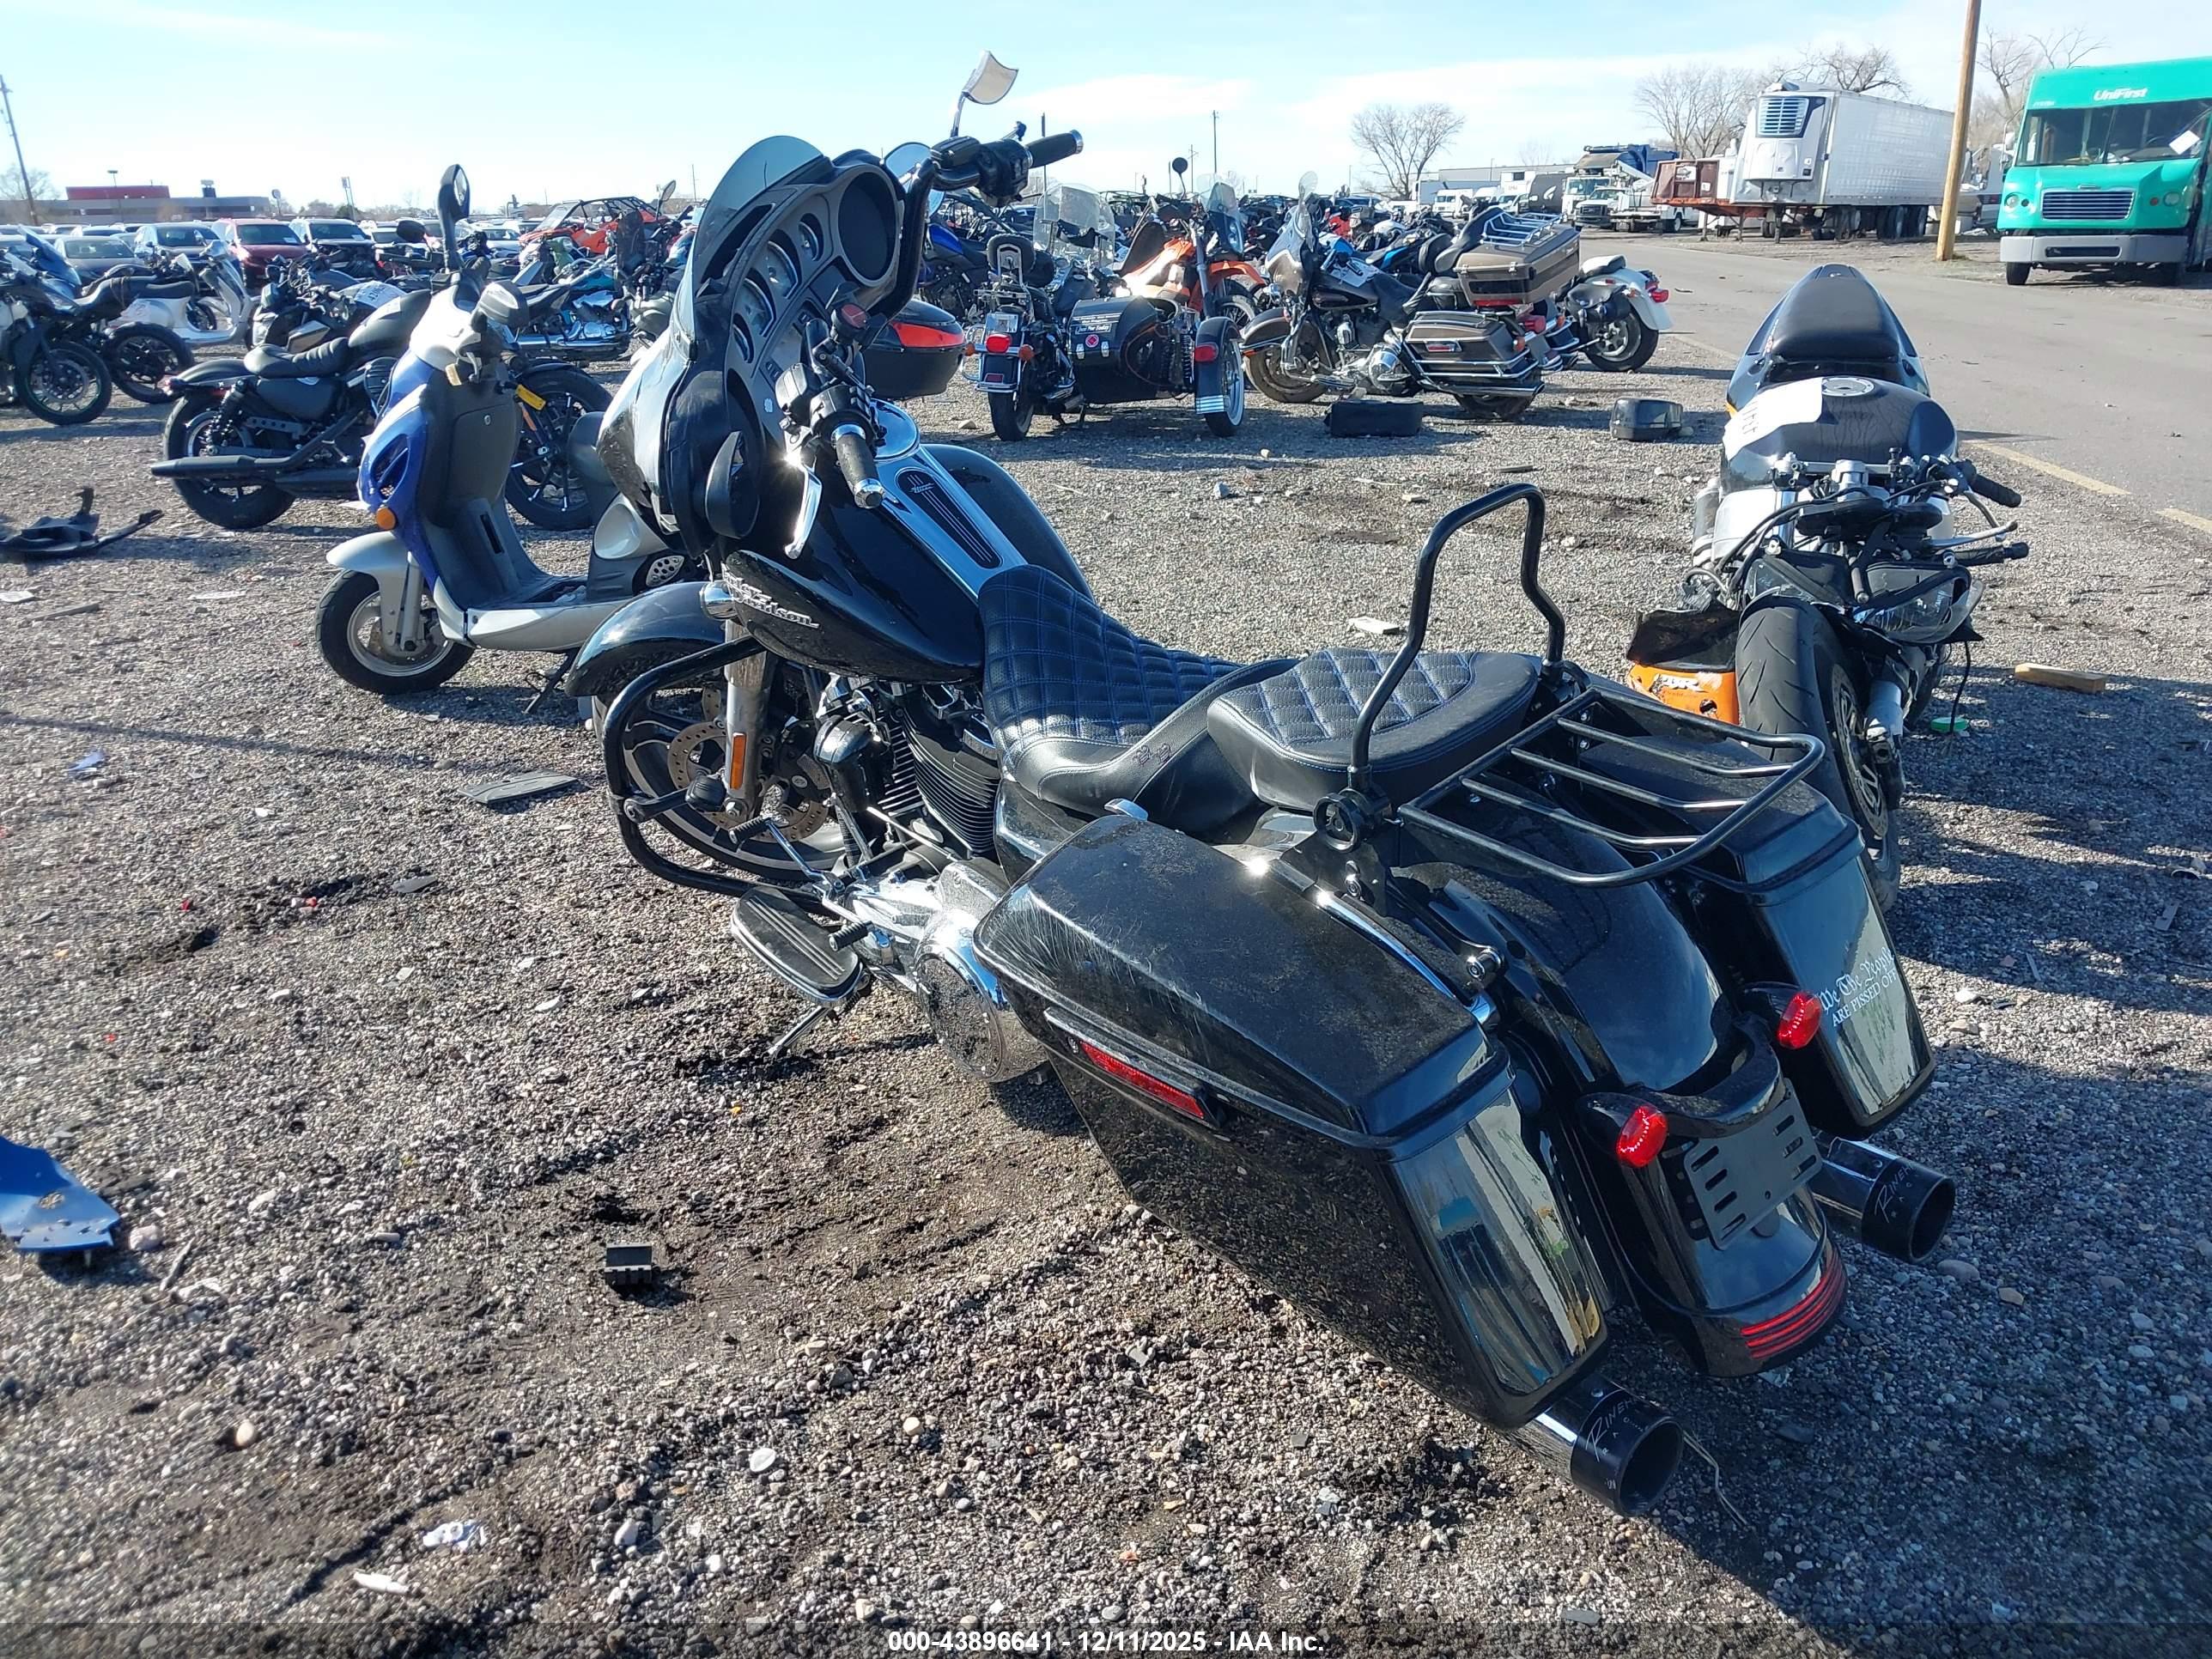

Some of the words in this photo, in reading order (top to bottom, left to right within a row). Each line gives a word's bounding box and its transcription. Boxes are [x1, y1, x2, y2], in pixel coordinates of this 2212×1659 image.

[2094, 88, 2148, 101] UniFirst
[1814, 988, 1841, 1015] We
[1836, 974, 1863, 996] The
[1860, 946, 1894, 988] People
[1832, 1004, 1852, 1027] ARE
[1850, 981, 1881, 1012] PISSED
[1881, 968, 1897, 988] OFF
